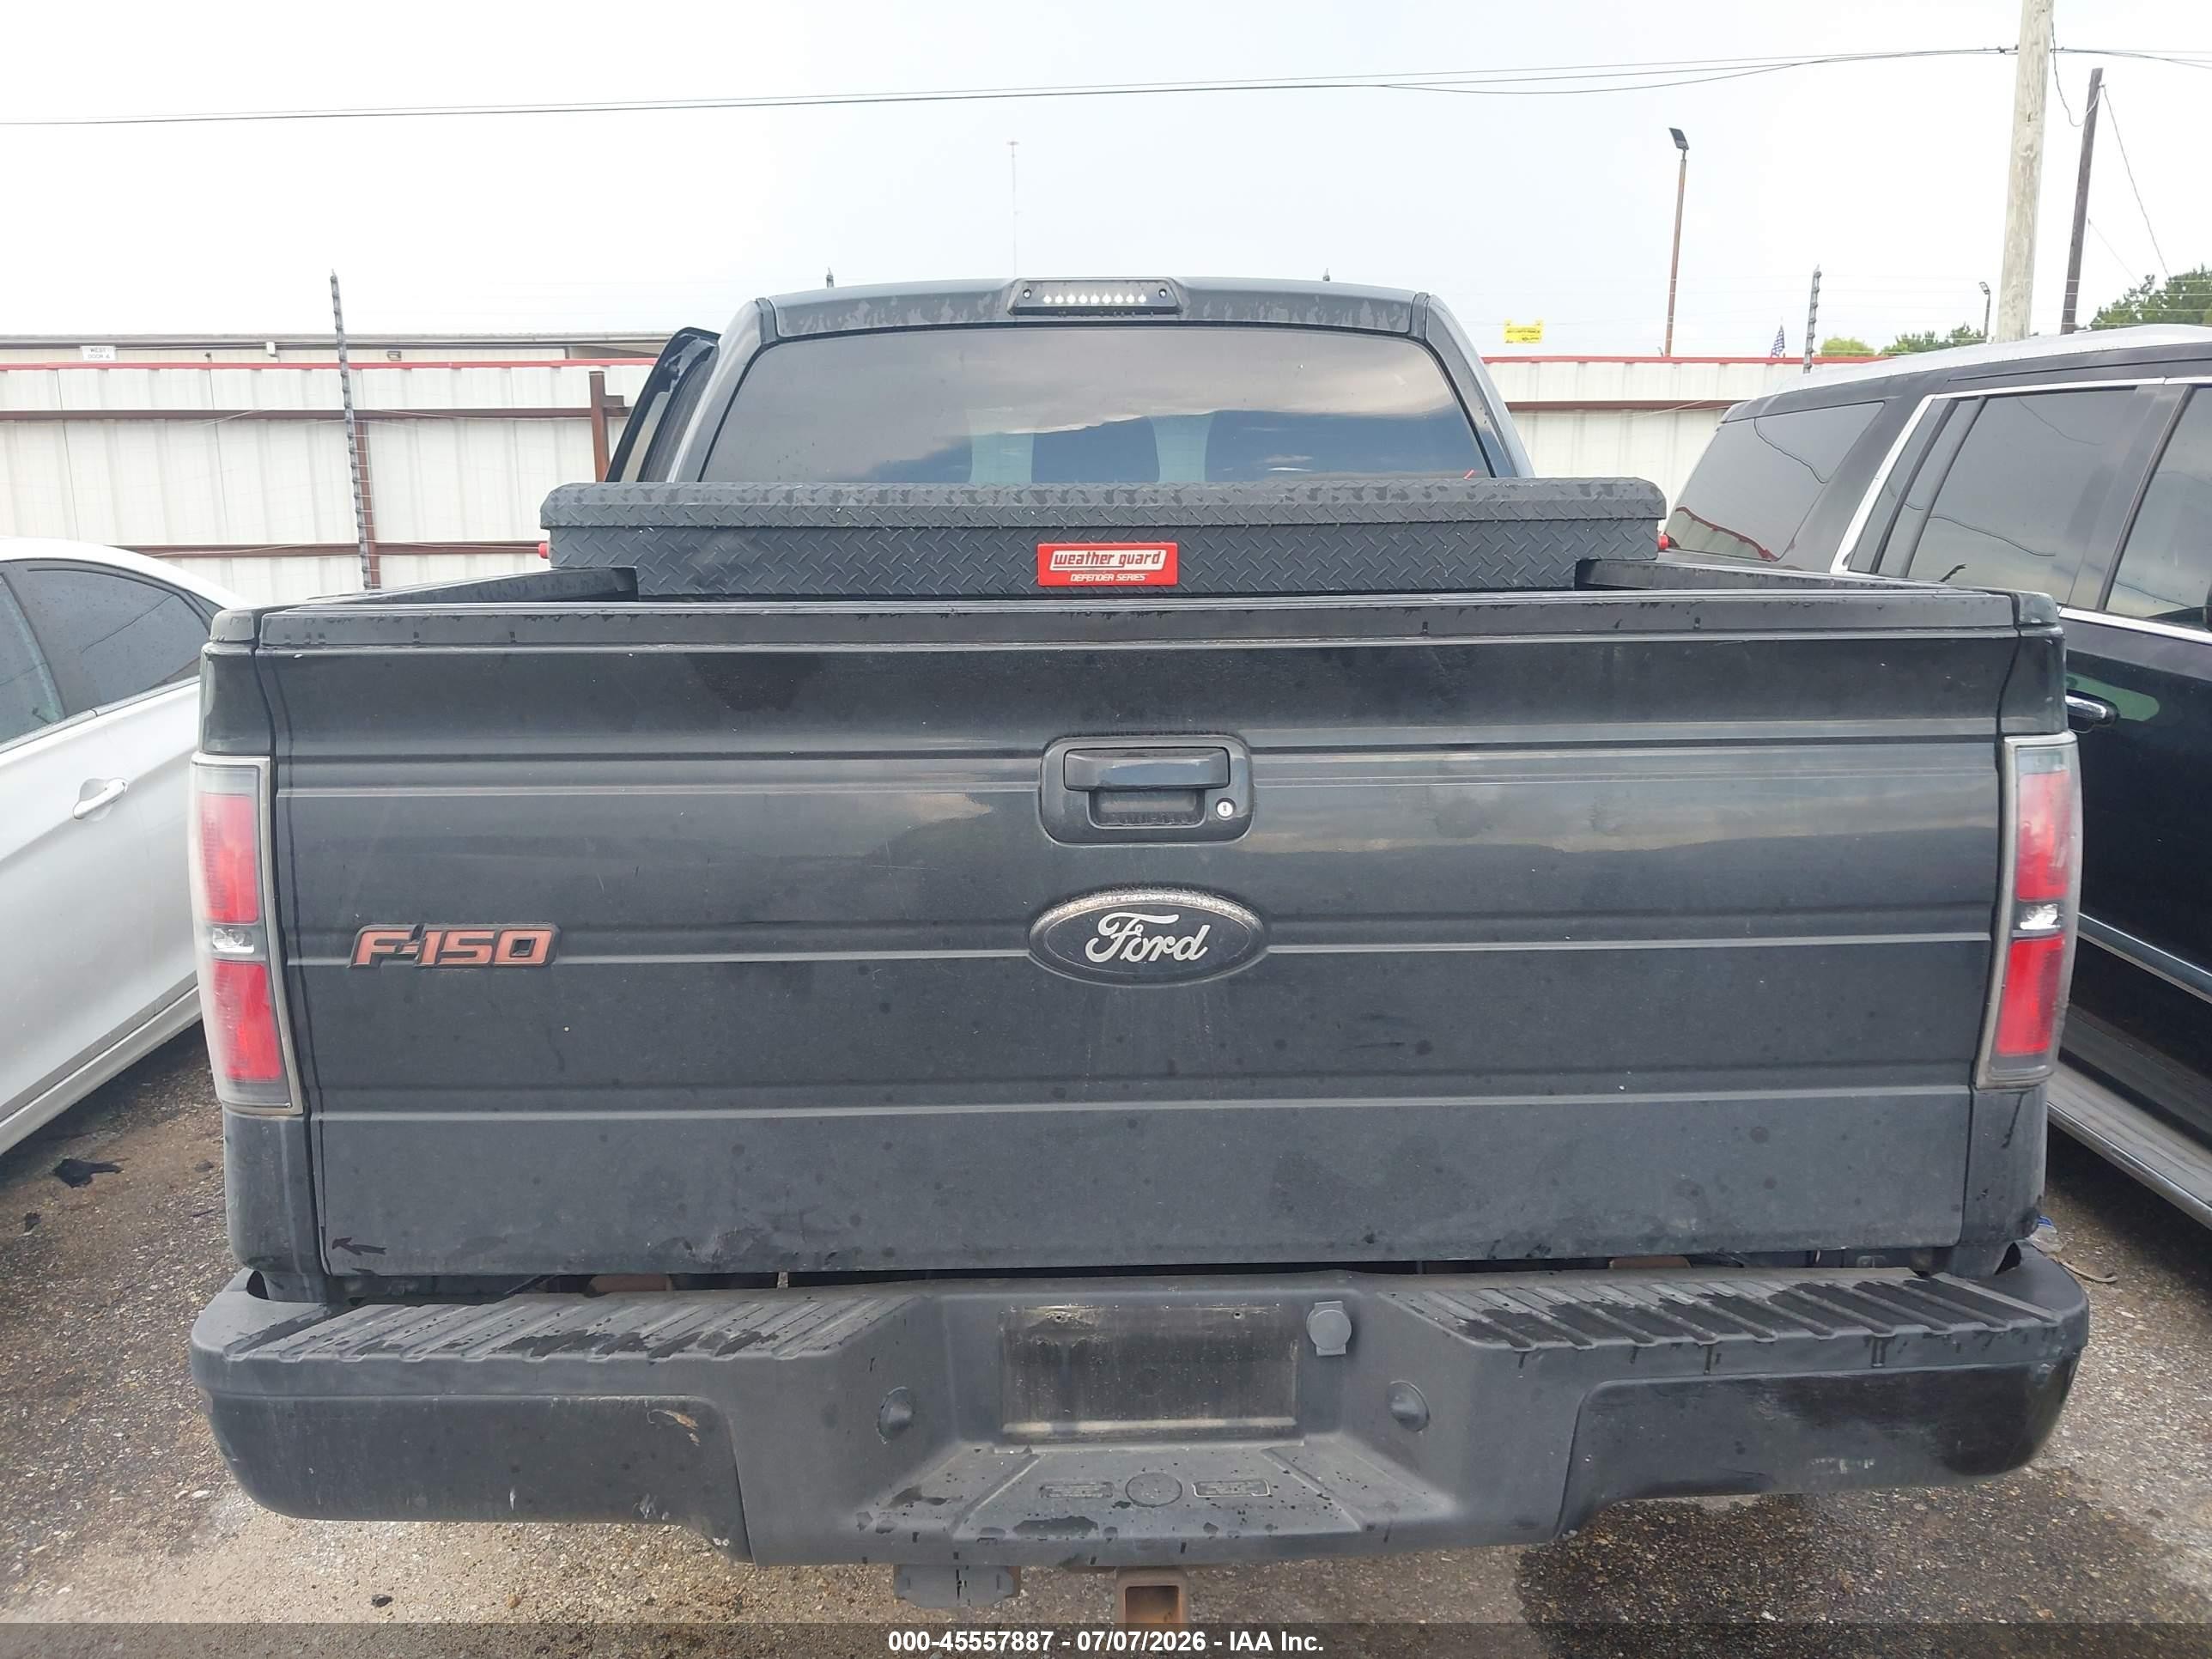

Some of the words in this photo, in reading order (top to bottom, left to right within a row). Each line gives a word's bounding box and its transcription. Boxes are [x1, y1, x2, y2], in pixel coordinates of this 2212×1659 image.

[1054, 551, 1115, 566] weather
[1118, 551, 1162, 566] guard
[1070, 573, 1115, 582] DEFENDER
[1115, 573, 1147, 581] SERIES
[349, 923, 559, 969] F-150
[1085, 911, 1212, 963] Ford
